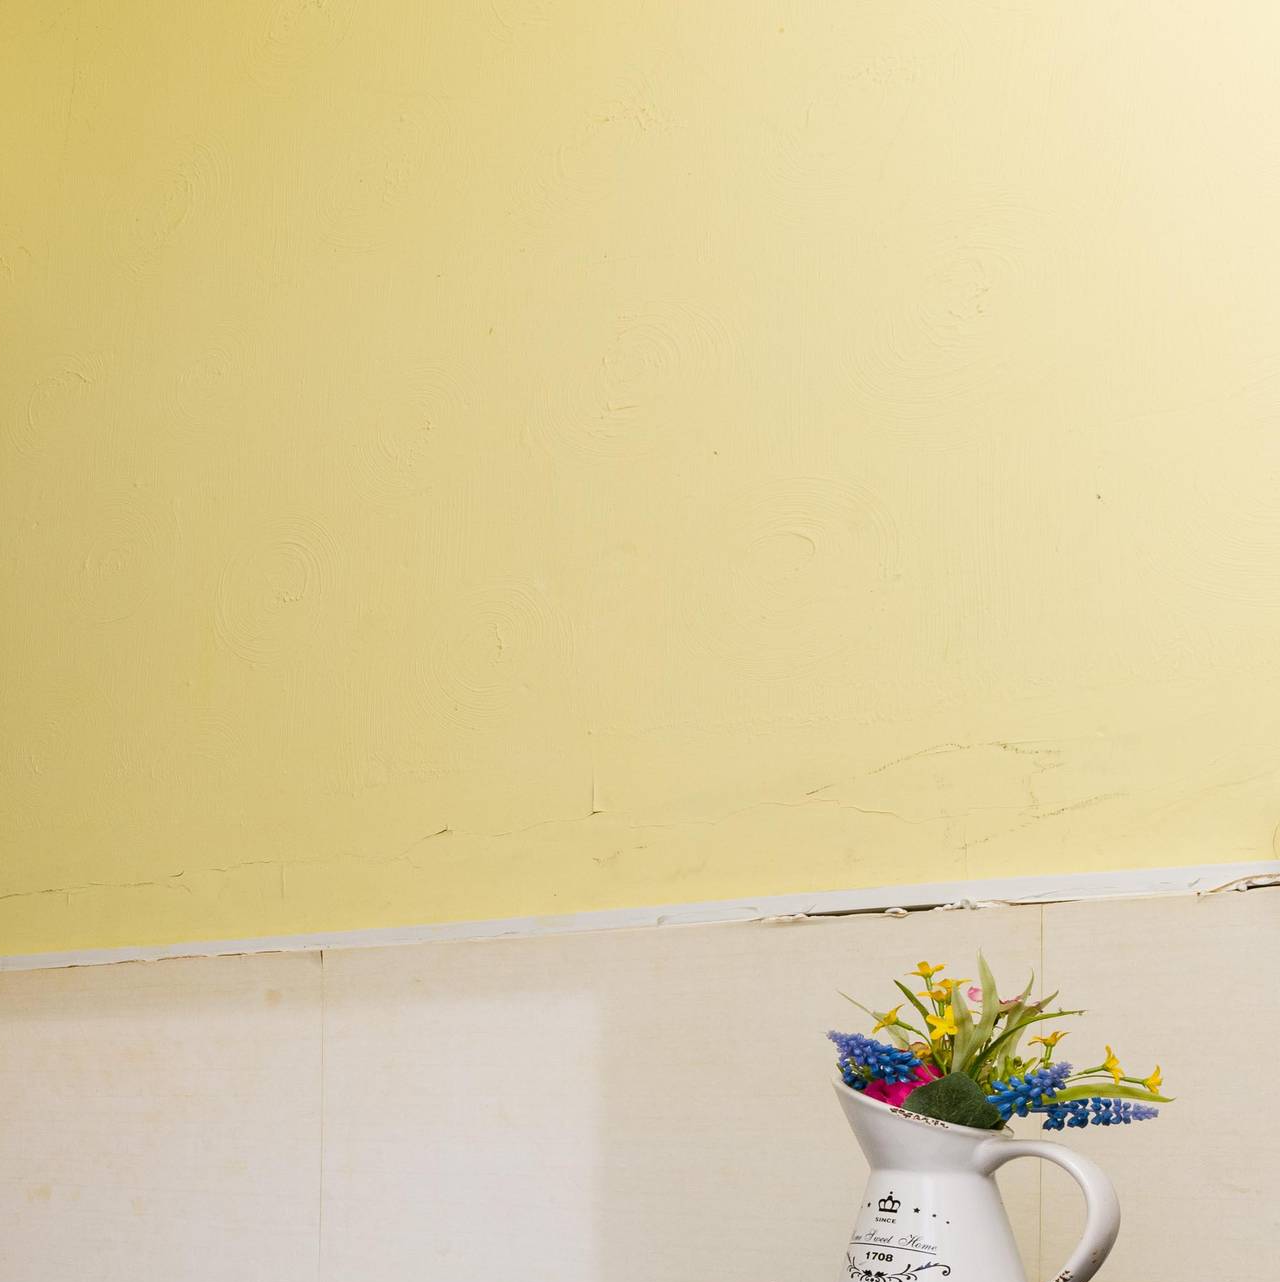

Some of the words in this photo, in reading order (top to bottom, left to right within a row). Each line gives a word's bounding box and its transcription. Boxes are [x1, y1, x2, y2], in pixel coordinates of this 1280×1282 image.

[875, 1216, 897, 1224] SINCE
[899, 1234, 938, 1251] Home
[865, 1251, 894, 1262] 1708
